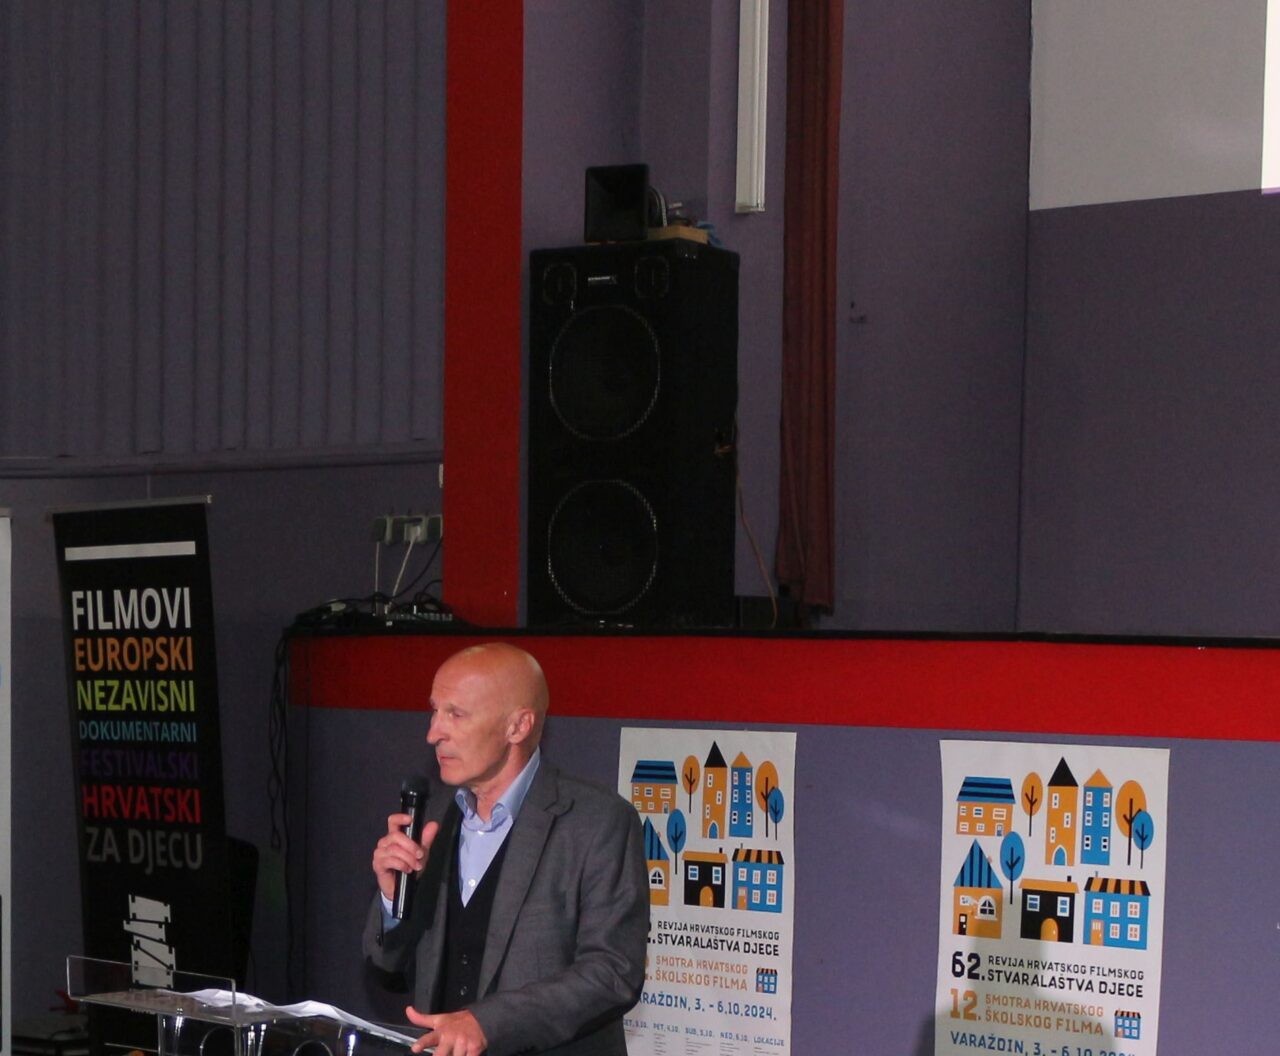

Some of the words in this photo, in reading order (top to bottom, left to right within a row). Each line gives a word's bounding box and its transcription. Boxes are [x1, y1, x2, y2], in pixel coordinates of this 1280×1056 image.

[72, 587, 192, 631] FILMOVI
[74, 636, 194, 672] EUROPSKI
[76, 679, 195, 712] NEZAVISNI
[79, 720, 197, 743] DOKUMENTARNI
[80, 747, 199, 780] FESTIVALSKI
[81, 784, 202, 825] HRVATSKI
[85, 826, 121, 864] ZA
[128, 827, 203, 876] DJECU
[658, 920, 688, 932] REVIJA
[690, 923, 734, 936] HRVATSKOG
[737, 928, 779, 940] FILMSKOG
[658, 932, 740, 952] STVARALAŠTVA
[743, 941, 779, 956] DJECE
[655, 967, 710, 986] ŠKOLSKOG
[713, 976, 747, 991] FILMA
[656, 955, 693, 969] SMOTRA
[696, 959, 748, 975] HRVATSKOG
[951, 951, 985, 981] 62.
[988, 955, 1024, 969] REVIJA
[1027, 959, 1086, 975] HRVATSKOG
[1090, 966, 1144, 980] FILMSKOG
[987, 969, 1094, 992] STVARALAŠTVA
[1099, 981, 1143, 998] DJECE
[639, 990, 691, 1012] RAŽDIN,
[718, 1001, 776, 1020] 6.10.2024.
[950, 988, 981, 1021] 12.
[985, 993, 1031, 1009] SMOTRA
[1034, 1001, 1104, 1017] HRVATSKOG
[985, 1005, 1051, 1029] ŠKOLSKOG
[1056, 1018, 1104, 1036] FILMA
